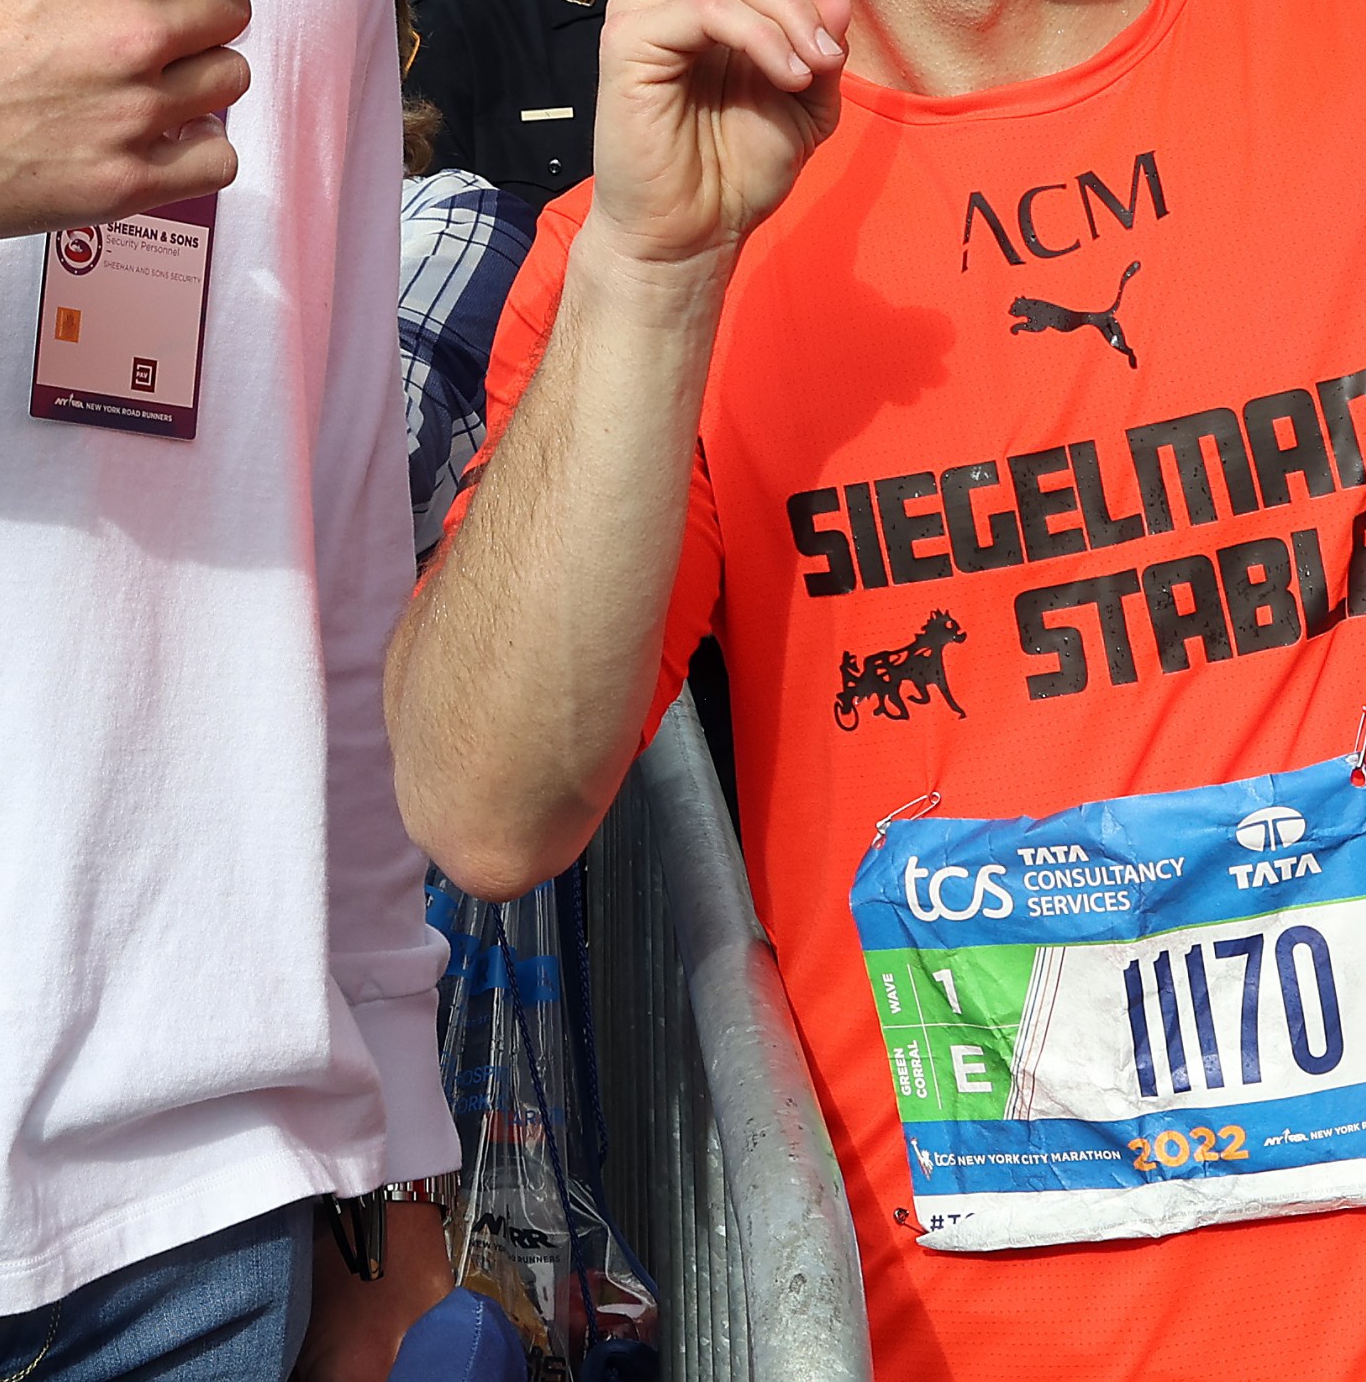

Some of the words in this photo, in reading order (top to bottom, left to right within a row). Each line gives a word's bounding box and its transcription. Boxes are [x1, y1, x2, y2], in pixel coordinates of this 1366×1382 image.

[960, 149, 1171, 274] ACM
[106, 221, 159, 241] SHEEHAN
[160, 231, 168, 243] &
[169, 233, 200, 249] SONS
[106, 234, 139, 251] Security
[140, 241, 181, 258] Personnel
[103, 260, 135, 274] SHEEHAN
[135, 266, 150, 277] AND
[151, 268, 169, 280] SONS
[170, 272, 202, 284] SECURITY
[85, 402, 102, 412] NEW
[102, 404, 122, 415] YORK
[121, 407, 141, 418] ROAD
[141, 410, 174, 423] RUNNERS
[1017, 844, 1090, 867] TATA
[1228, 852, 1323, 890] TATA
[1023, 856, 1186, 892] CONSULTANCY
[1026, 890, 1131, 918] SERVICES
[881, 972, 902, 1015] WAVE
[932, 968, 963, 1015] 1
[1122, 924, 1345, 1098] 11170
[892, 1047, 913, 1097] GREEN
[906, 1039, 928, 1099] CORRAL
[949, 1044, 993, 1094] E
[1309, 1128, 1334, 1141] NEW
[1334, 1122, 1362, 1136] YORK
[957, 1153, 986, 1166] NEW
[986, 1153, 1021, 1165] YORK
[1021, 1152, 1049, 1165] CITY
[1051, 1149, 1122, 1163] MARATHON
[1127, 1124, 1250, 1172] 2022
